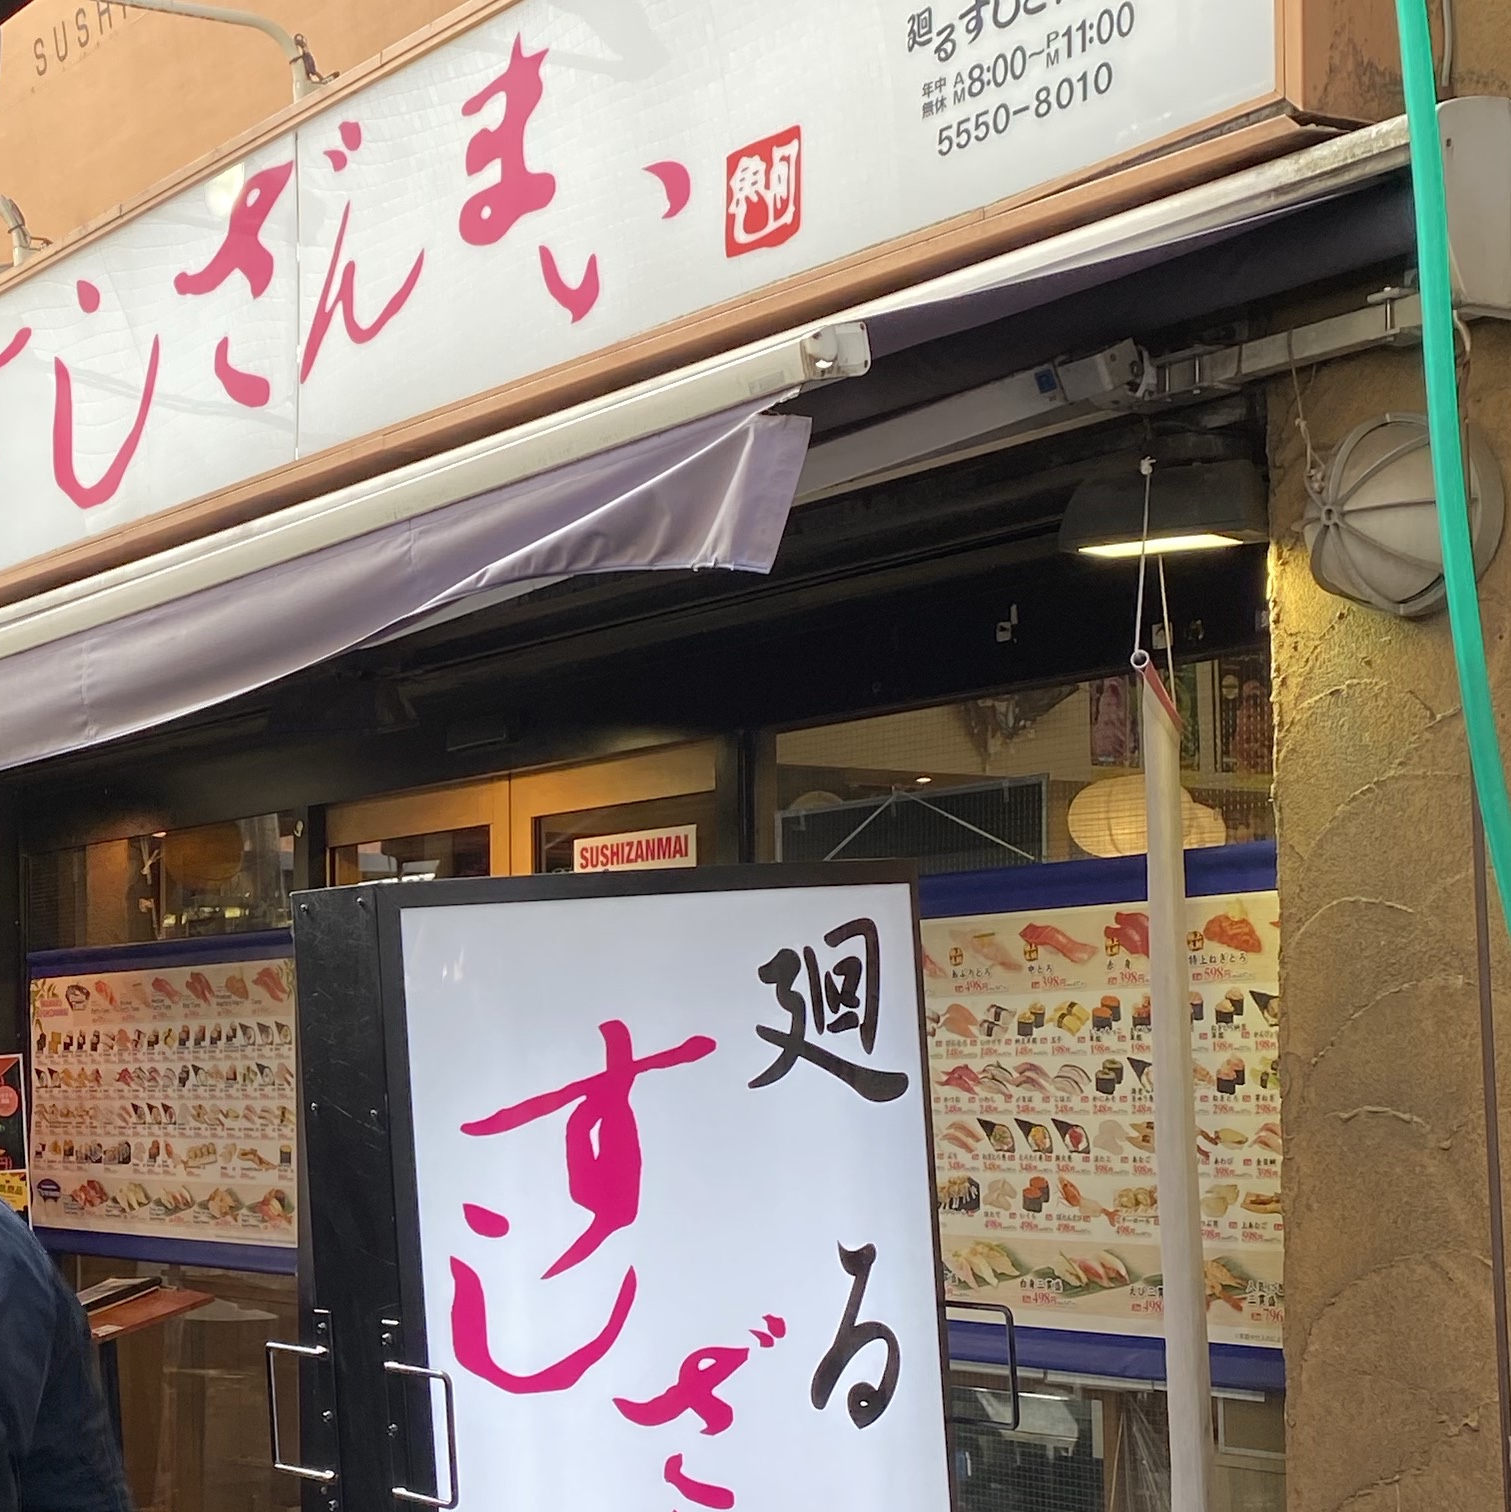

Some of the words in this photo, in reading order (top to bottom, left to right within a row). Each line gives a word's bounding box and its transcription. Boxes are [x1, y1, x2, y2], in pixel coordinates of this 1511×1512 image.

[937, 62, 1112, 156] 5550-8010
[579, 833, 689, 870] SUSHIZANMAI
[749, 918, 908, 1429] 廻る
